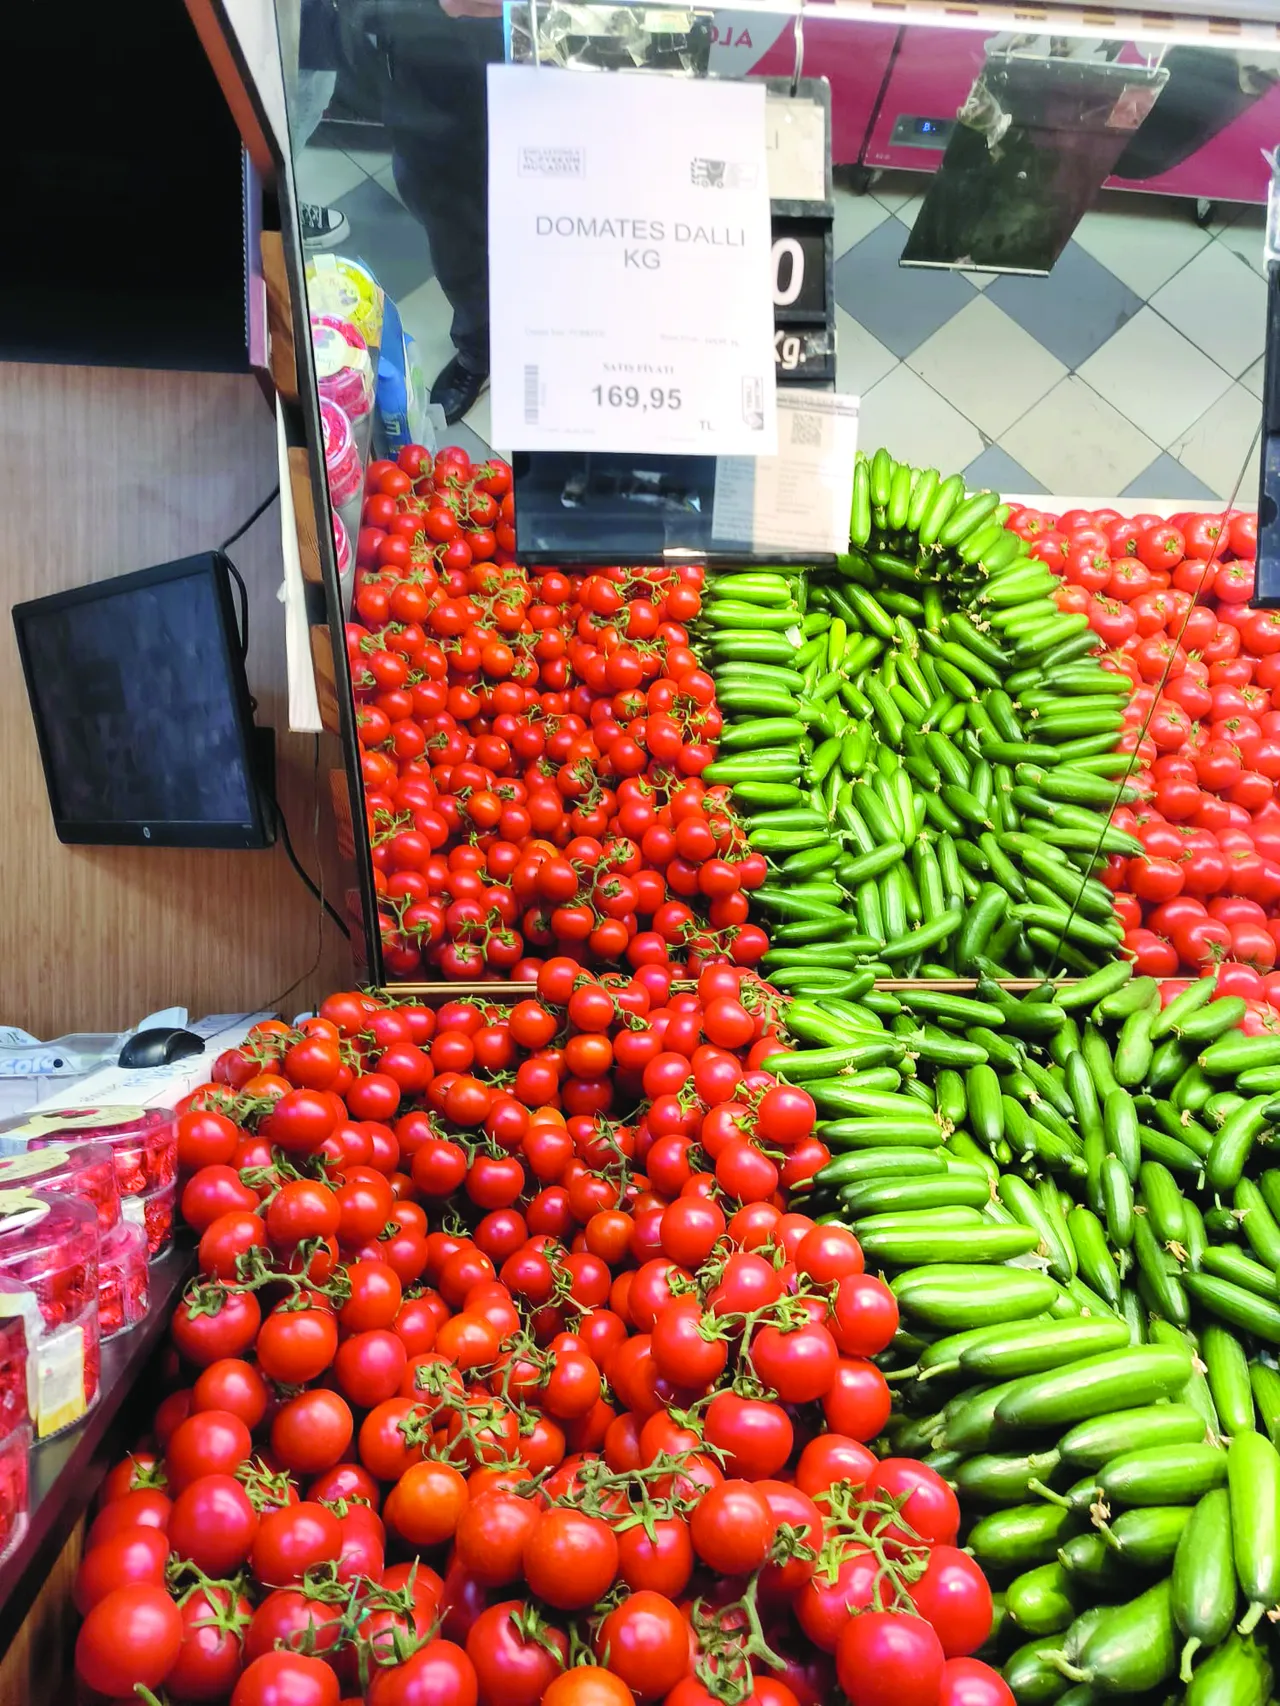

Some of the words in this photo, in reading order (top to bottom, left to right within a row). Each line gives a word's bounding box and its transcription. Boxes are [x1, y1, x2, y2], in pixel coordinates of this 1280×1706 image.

[536, 215, 666, 241] DOMATES
[674, 222, 746, 247] DALLI
[624, 248, 662, 270] KG
[771, 237, 805, 306] 0
[592, 384, 683, 414] 169,95
[699, 419, 716, 432] TL
